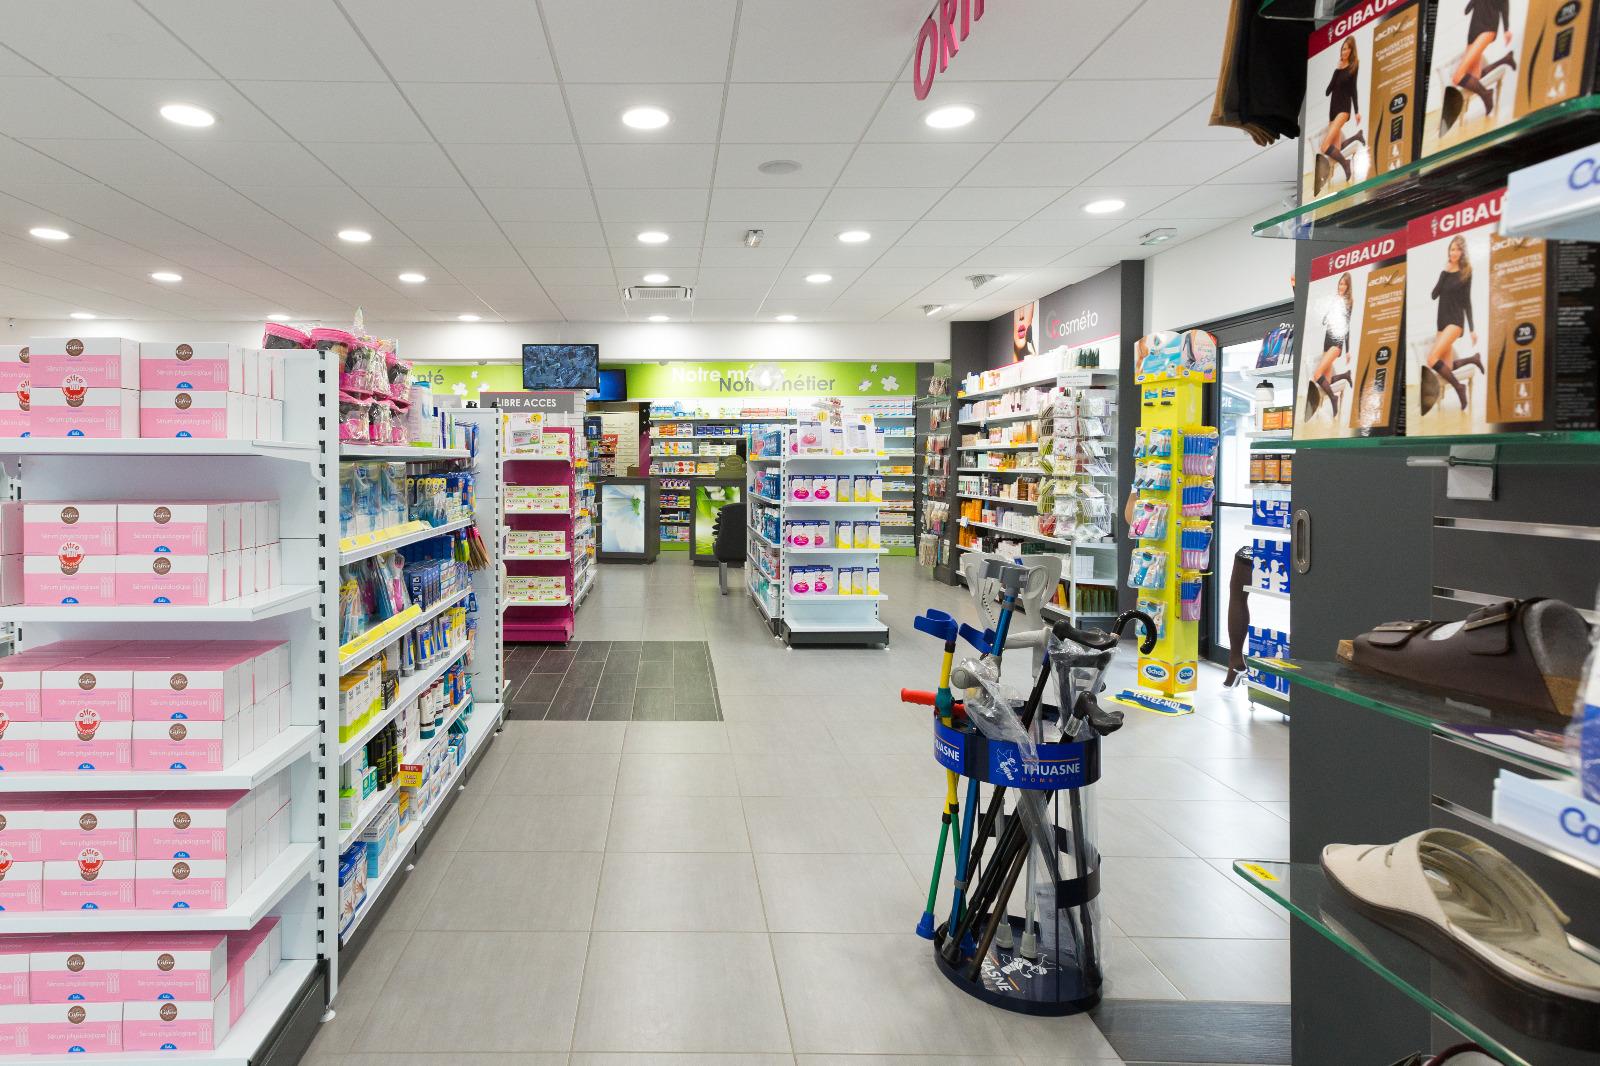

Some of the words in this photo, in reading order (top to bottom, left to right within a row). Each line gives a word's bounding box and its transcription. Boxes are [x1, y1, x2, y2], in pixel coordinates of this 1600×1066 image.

[1334, 239, 1395, 269] GIBAUD
[415, 368, 445, 386] nté
[671, 367, 721, 384] Notre
[496, 397, 521, 408] LIBRE
[523, 397, 557, 408] ACCES
[1146, 666, 1167, 678] Scholl
[1022, 762, 1081, 776] THUASNE
